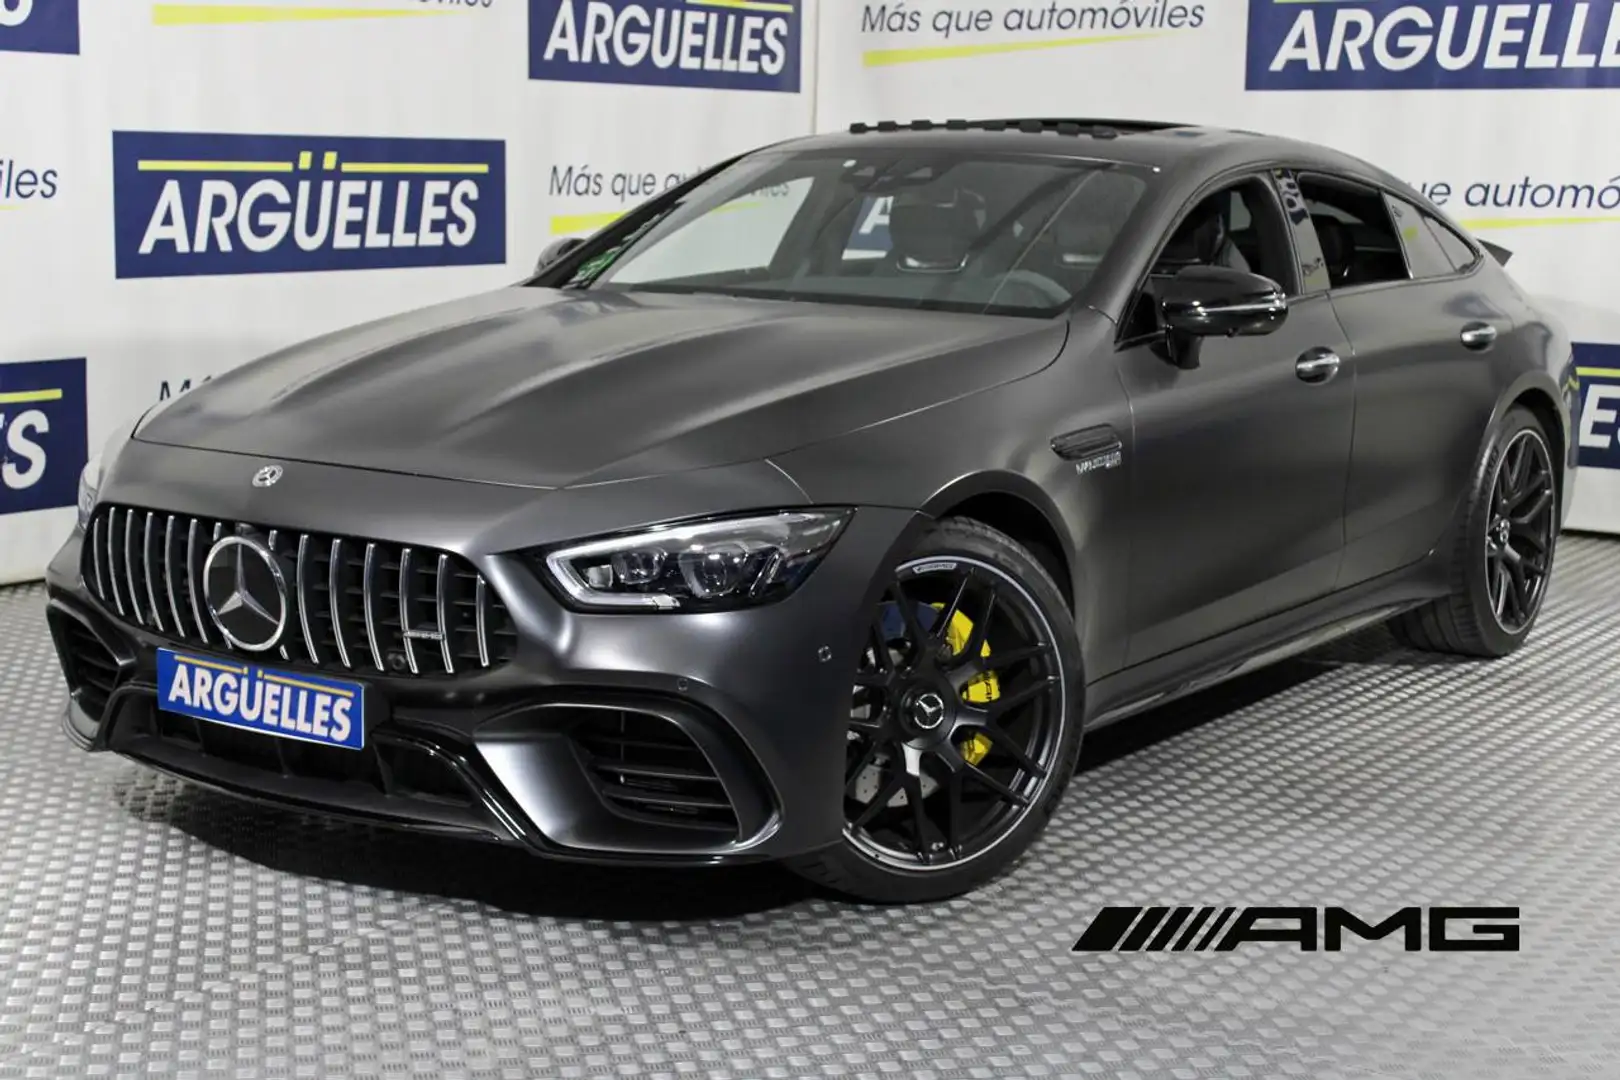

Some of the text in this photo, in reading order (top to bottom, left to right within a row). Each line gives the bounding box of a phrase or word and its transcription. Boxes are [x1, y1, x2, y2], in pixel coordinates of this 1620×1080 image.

[861, 0, 1205, 38] Más que automóviles
[138, 150, 479, 255] ARGÜELLES
[549, 165, 603, 197] Más
[611, 173, 657, 202] que
[168, 665, 353, 742] ARGÜELLES
